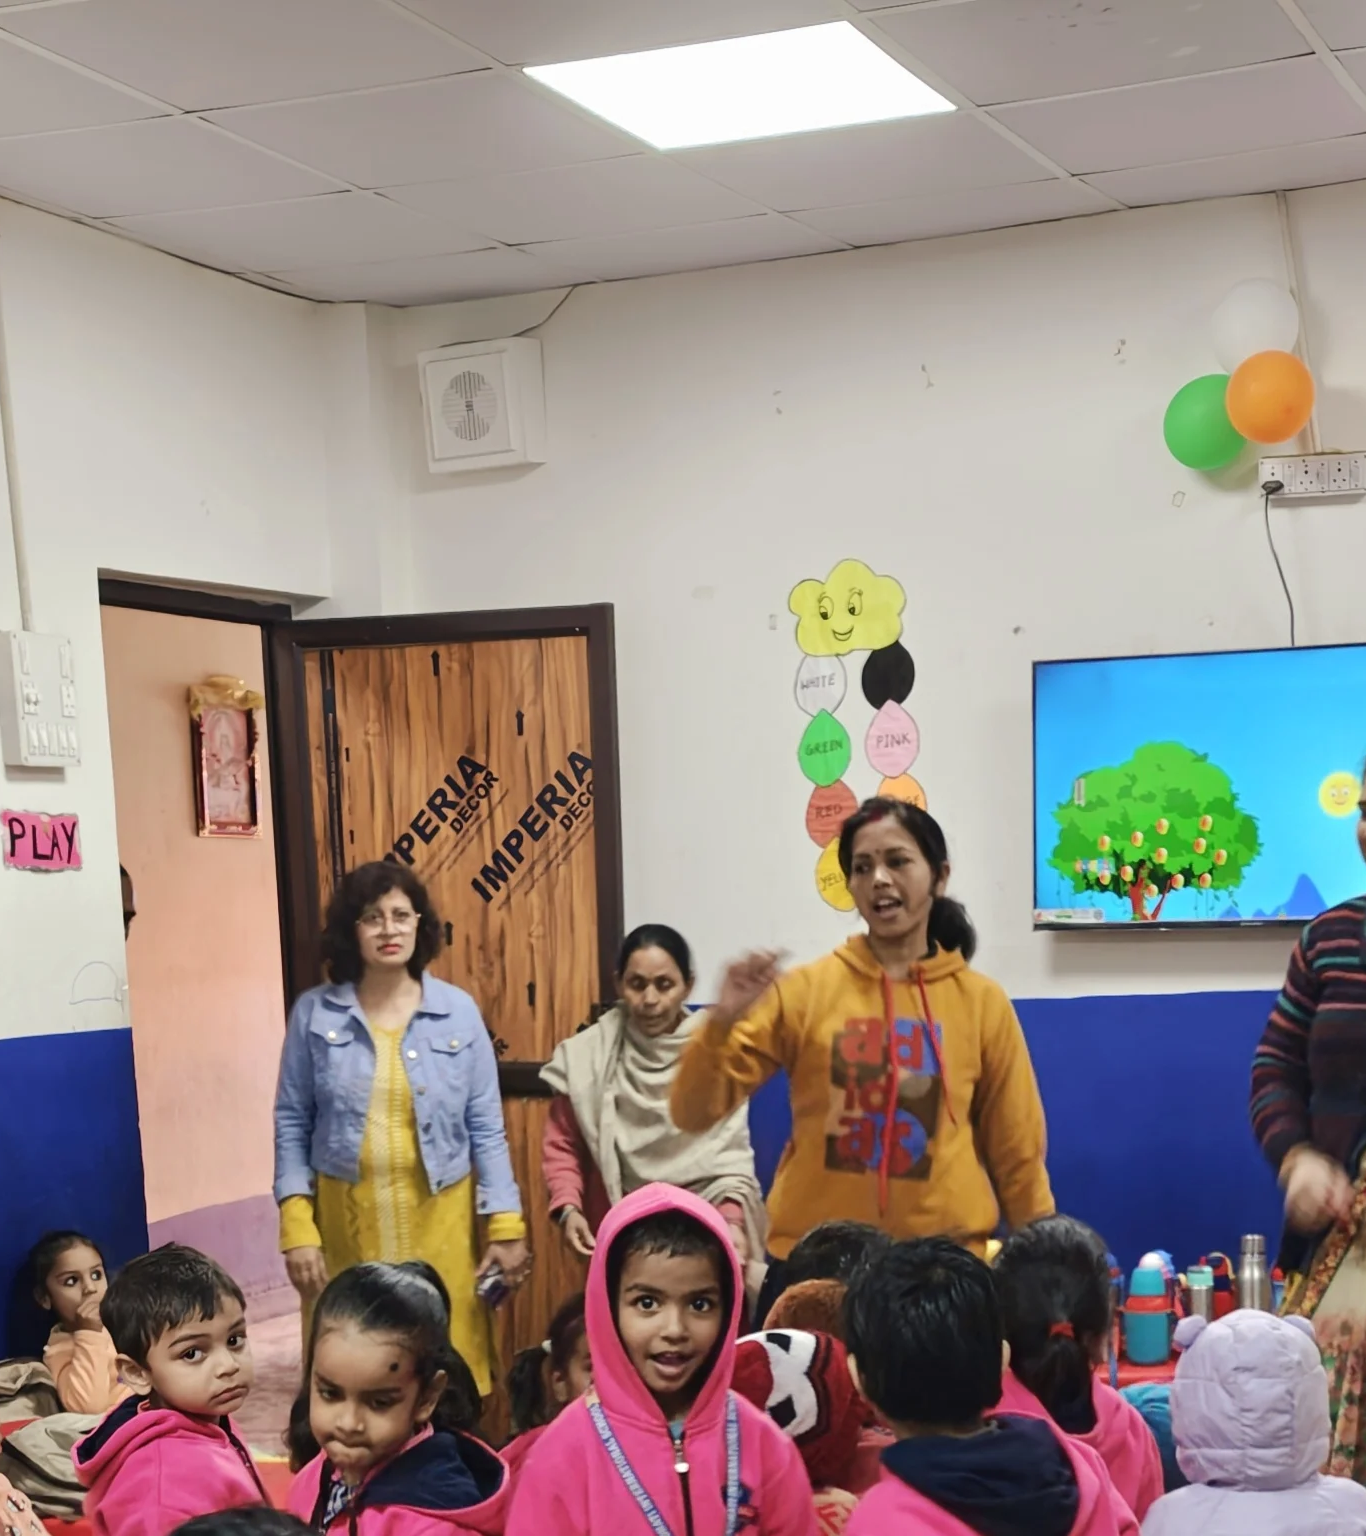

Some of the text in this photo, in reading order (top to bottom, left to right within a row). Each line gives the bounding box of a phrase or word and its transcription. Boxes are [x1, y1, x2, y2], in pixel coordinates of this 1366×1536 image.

[800, 673, 836, 690] WHITE
[804, 738, 843, 756] GREEN
[876, 732, 911, 749] PINK
[384, 755, 487, 865] PERIA
[449, 770, 499, 834] DECOR
[816, 803, 843, 819] RED
[7, 817, 77, 865] PLAY
[589, 1403, 612, 1440] SCHOOL
[605, 1437, 653, 1511] INTERNATIONAL
